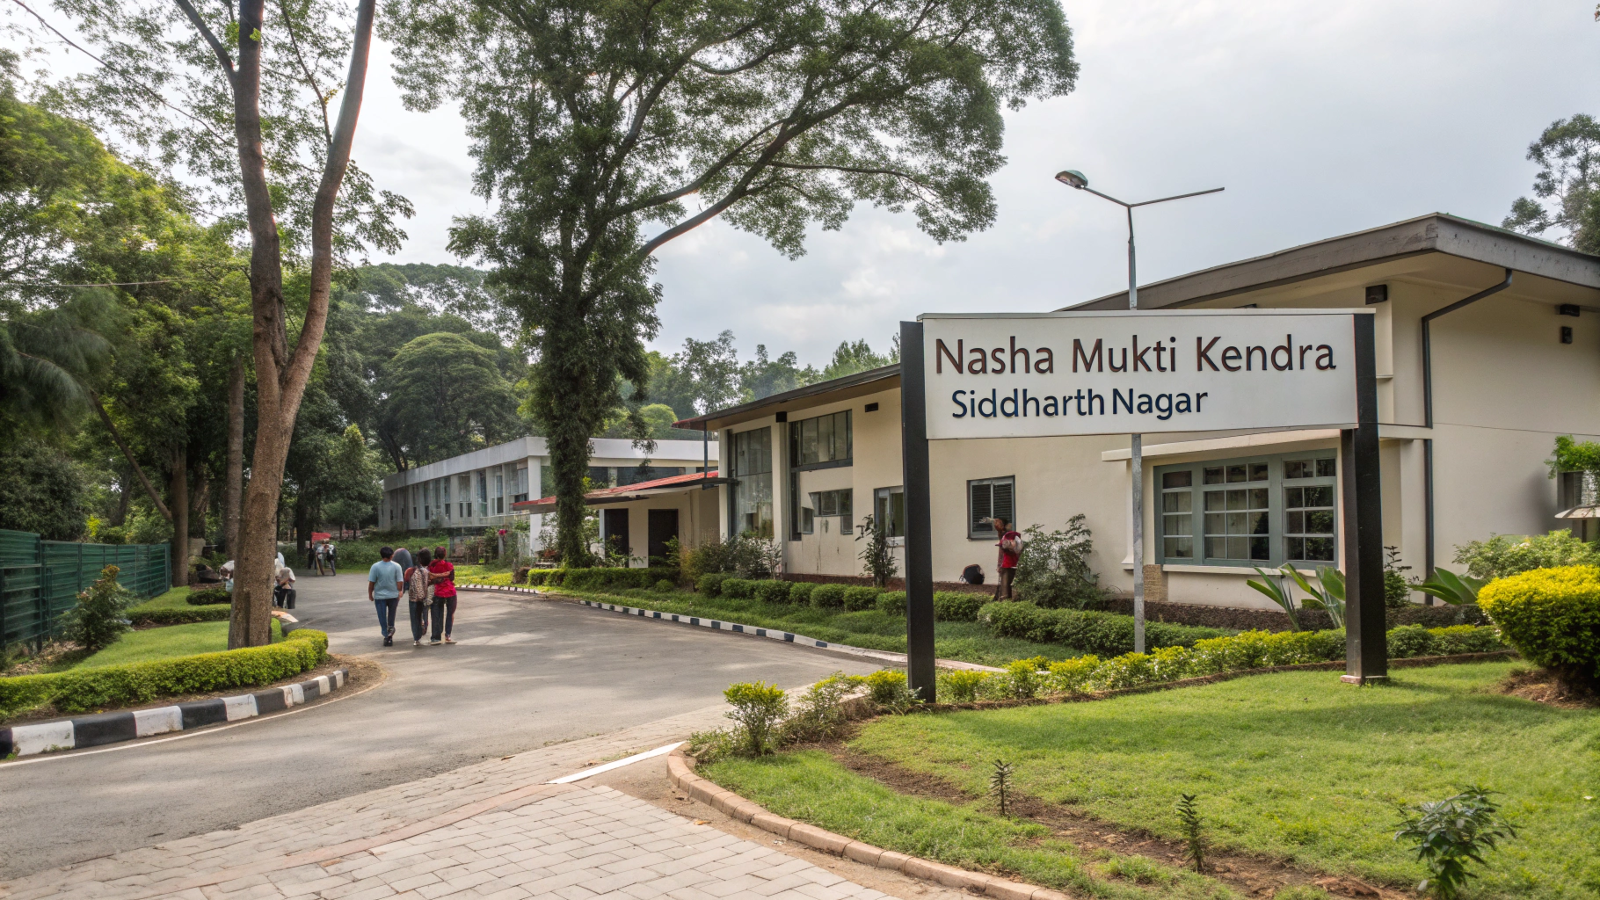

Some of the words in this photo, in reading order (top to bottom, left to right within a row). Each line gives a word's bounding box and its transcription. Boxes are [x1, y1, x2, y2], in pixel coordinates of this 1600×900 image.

[935, 335, 1055, 376] Nasha
[1072, 334, 1177, 374] Mukti
[1196, 333, 1337, 373] Kendra
[951, 387, 1105, 419] Siddharth
[1112, 387, 1209, 421] Nagar
